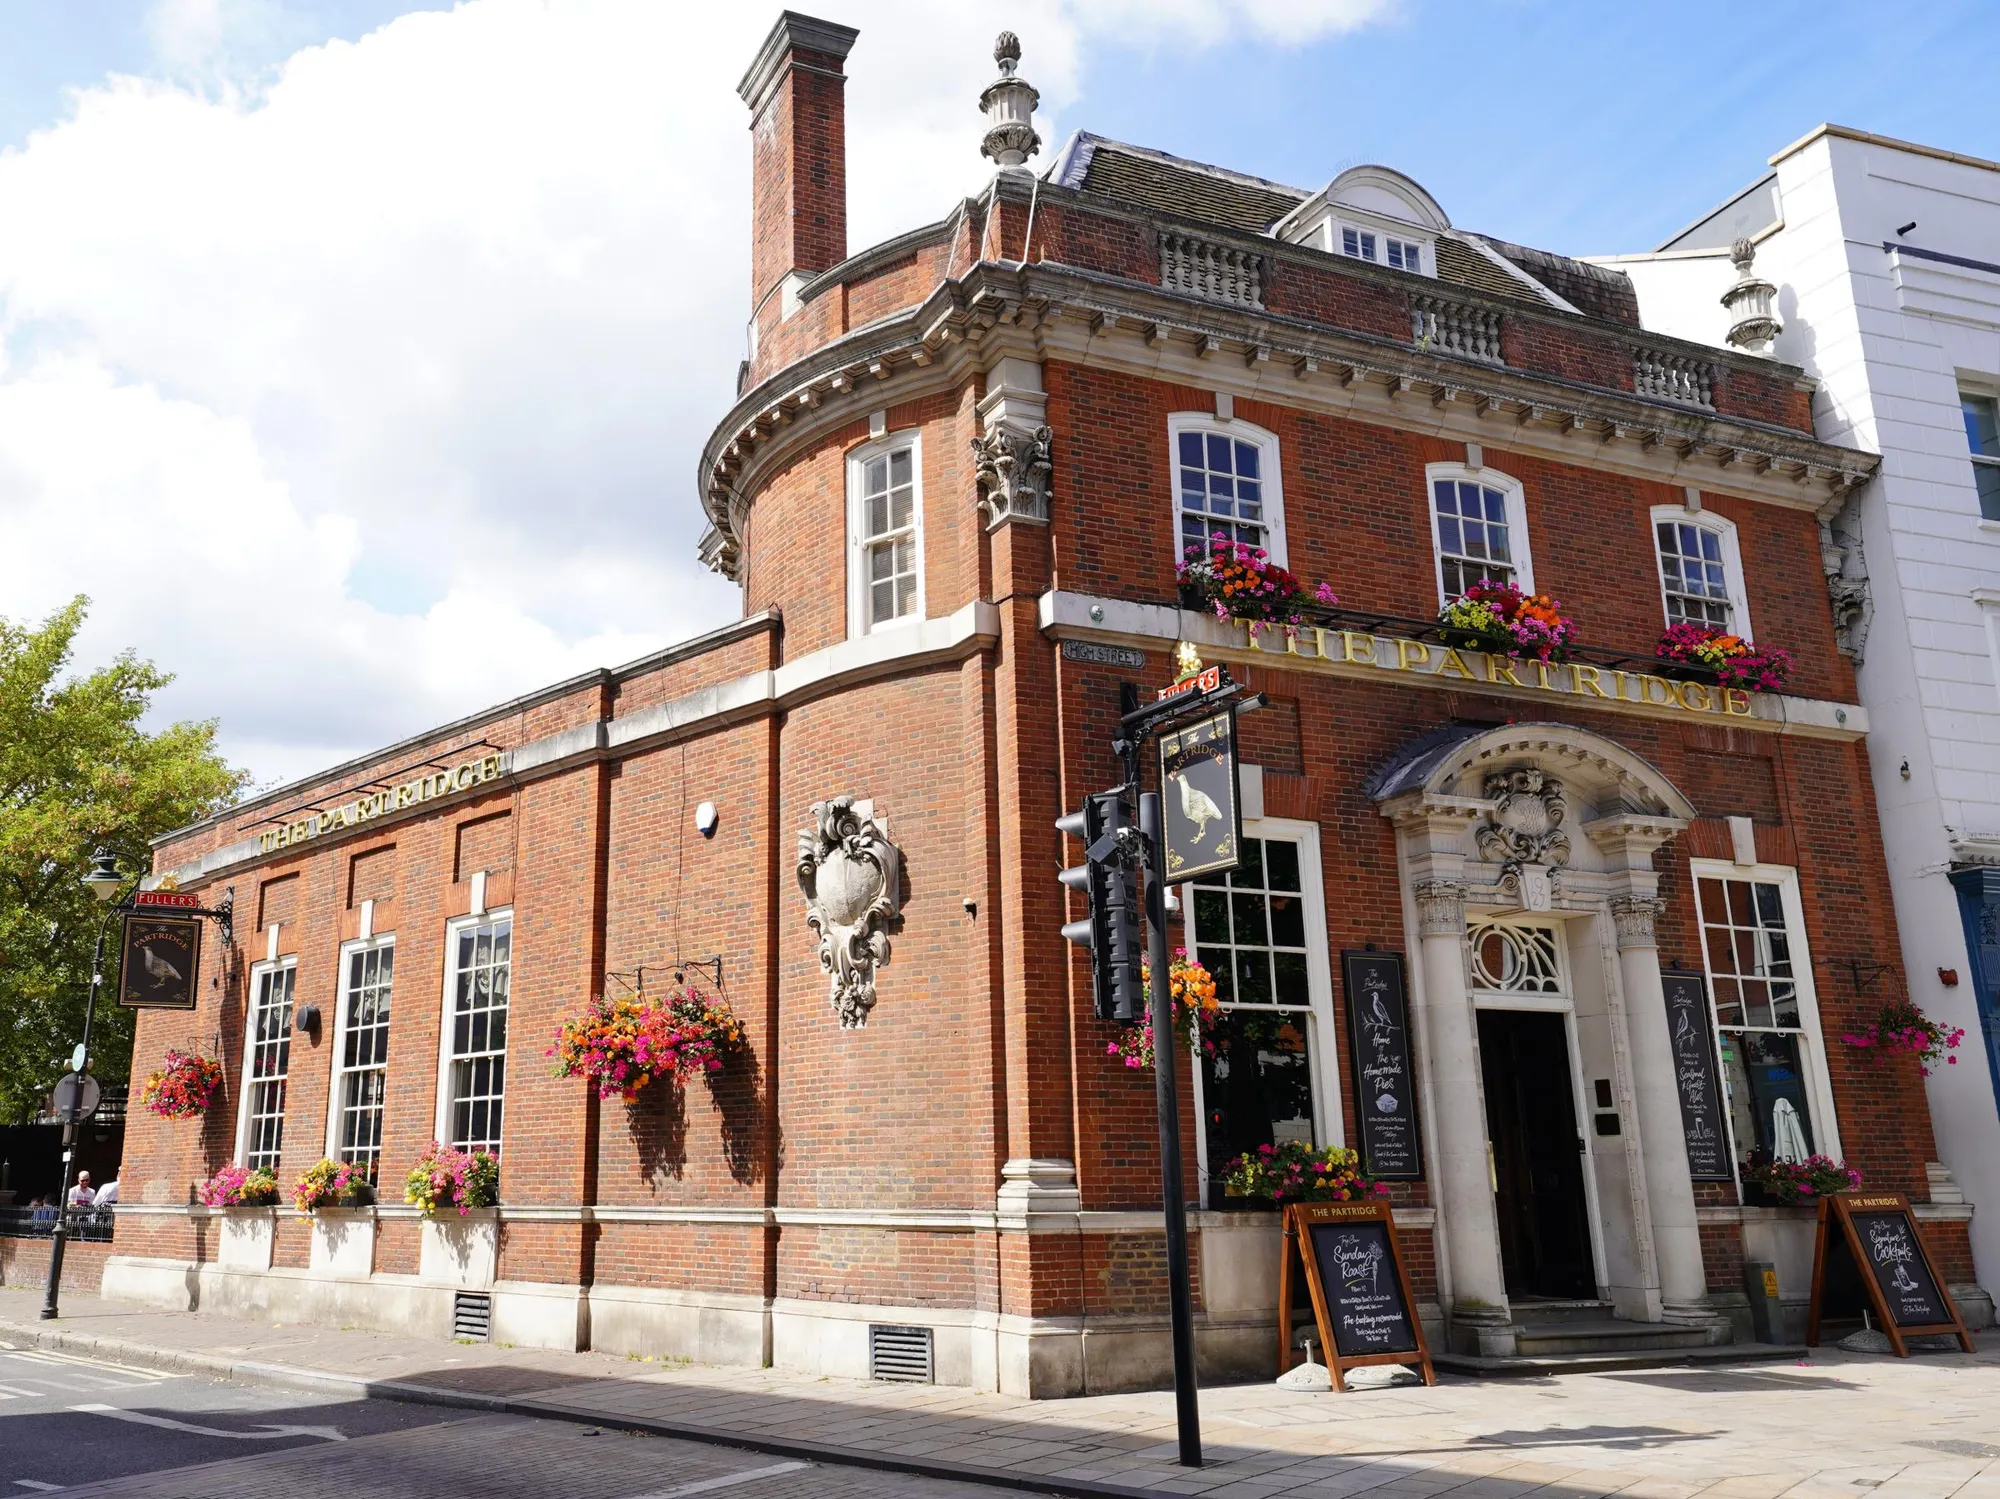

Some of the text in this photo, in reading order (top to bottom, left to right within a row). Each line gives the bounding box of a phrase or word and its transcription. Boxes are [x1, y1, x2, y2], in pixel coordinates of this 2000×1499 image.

[1069, 644, 1141, 665] HIGH STREET
[1232, 616, 1752, 718] THE PARTRIDGE
[1186, 731, 1200, 745] The
[1167, 744, 1225, 782] PARTRIDGE
[259, 754, 502, 854] THE PARTRIDGE
[138, 893, 194, 906] FULLER'S
[133, 932, 190, 952] PARTRIDGE
[1371, 1032, 1391, 1047] Home
[1373, 1076, 1395, 1094] Pies
[1311, 1206, 1378, 1217] THE PARTRIDGE
[1849, 1197, 1900, 1207] THE PARTRIDGE
[1869, 1229, 1902, 1246] Signature
[1333, 1245, 1374, 1265] Sunday
[1874, 1242, 1913, 1262] Cocktails
[1340, 1261, 1373, 1280] Roast
